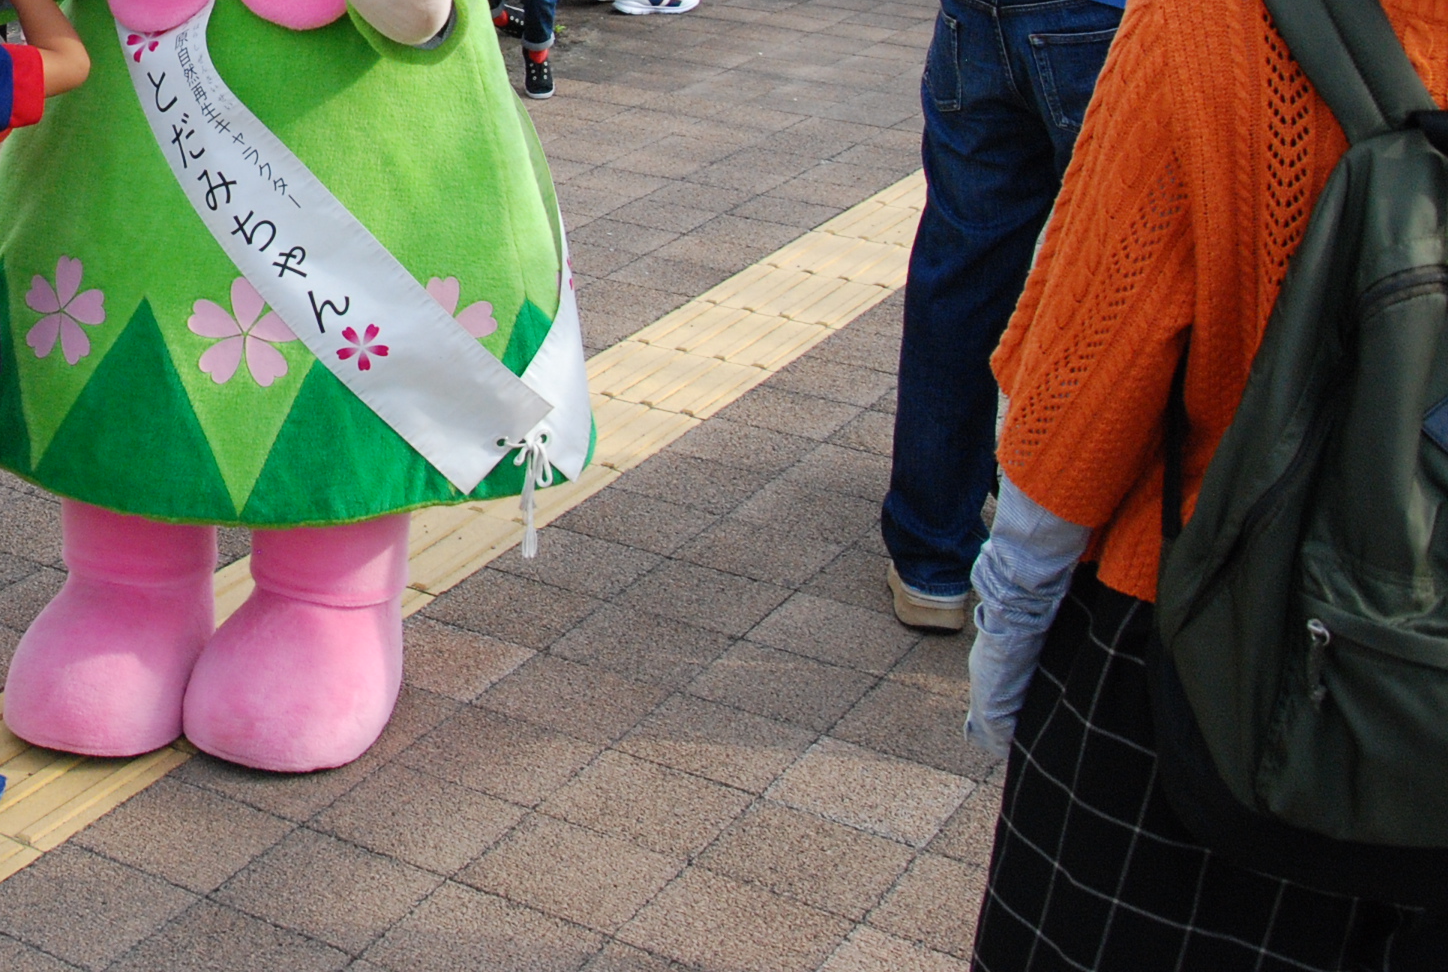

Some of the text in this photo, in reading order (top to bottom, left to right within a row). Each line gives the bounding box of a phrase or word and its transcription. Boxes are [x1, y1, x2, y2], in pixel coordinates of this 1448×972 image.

[146, 71, 350, 334] とだみちゃん
[174, 22, 302, 209] 原自然再生キャラクター
